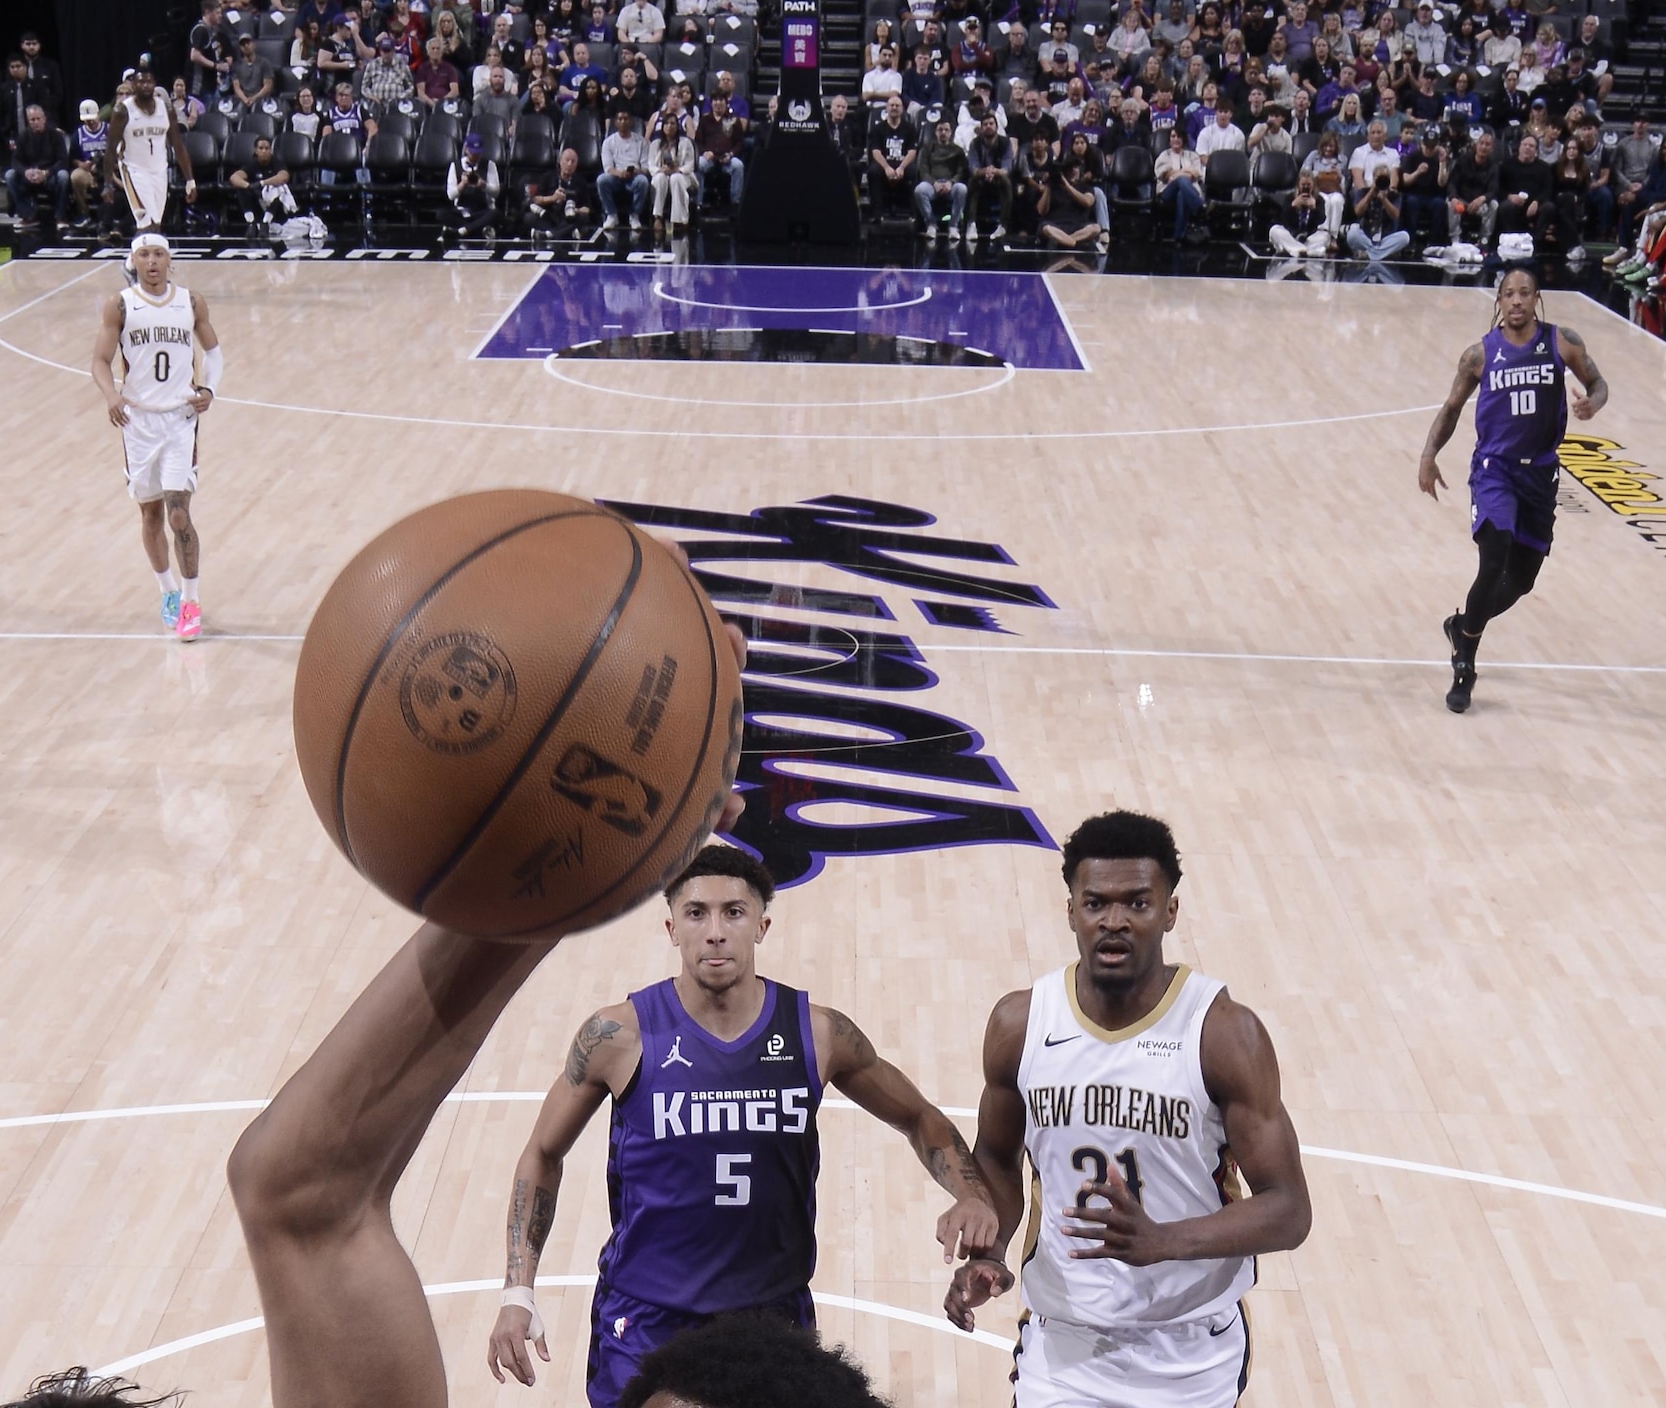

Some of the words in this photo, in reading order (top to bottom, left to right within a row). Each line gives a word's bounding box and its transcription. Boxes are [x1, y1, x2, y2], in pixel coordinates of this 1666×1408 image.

[784, 1, 816, 11] PATH
[779, 121, 820, 129] REDHAWK
[129, 327, 151, 347] NEW
[153, 326, 191, 347] ORLEANS
[154, 351, 171, 382] 0
[1510, 390, 1536, 416] 10
[1136, 1040, 1183, 1051] NEWAGE
[691, 1088, 777, 1101] SACRAMENTO
[1027, 1085, 1077, 1128] NEW
[1083, 1083, 1190, 1139] ORLEANS
[715, 1154, 752, 1206] 5
[1071, 1145, 1145, 1212] 21
